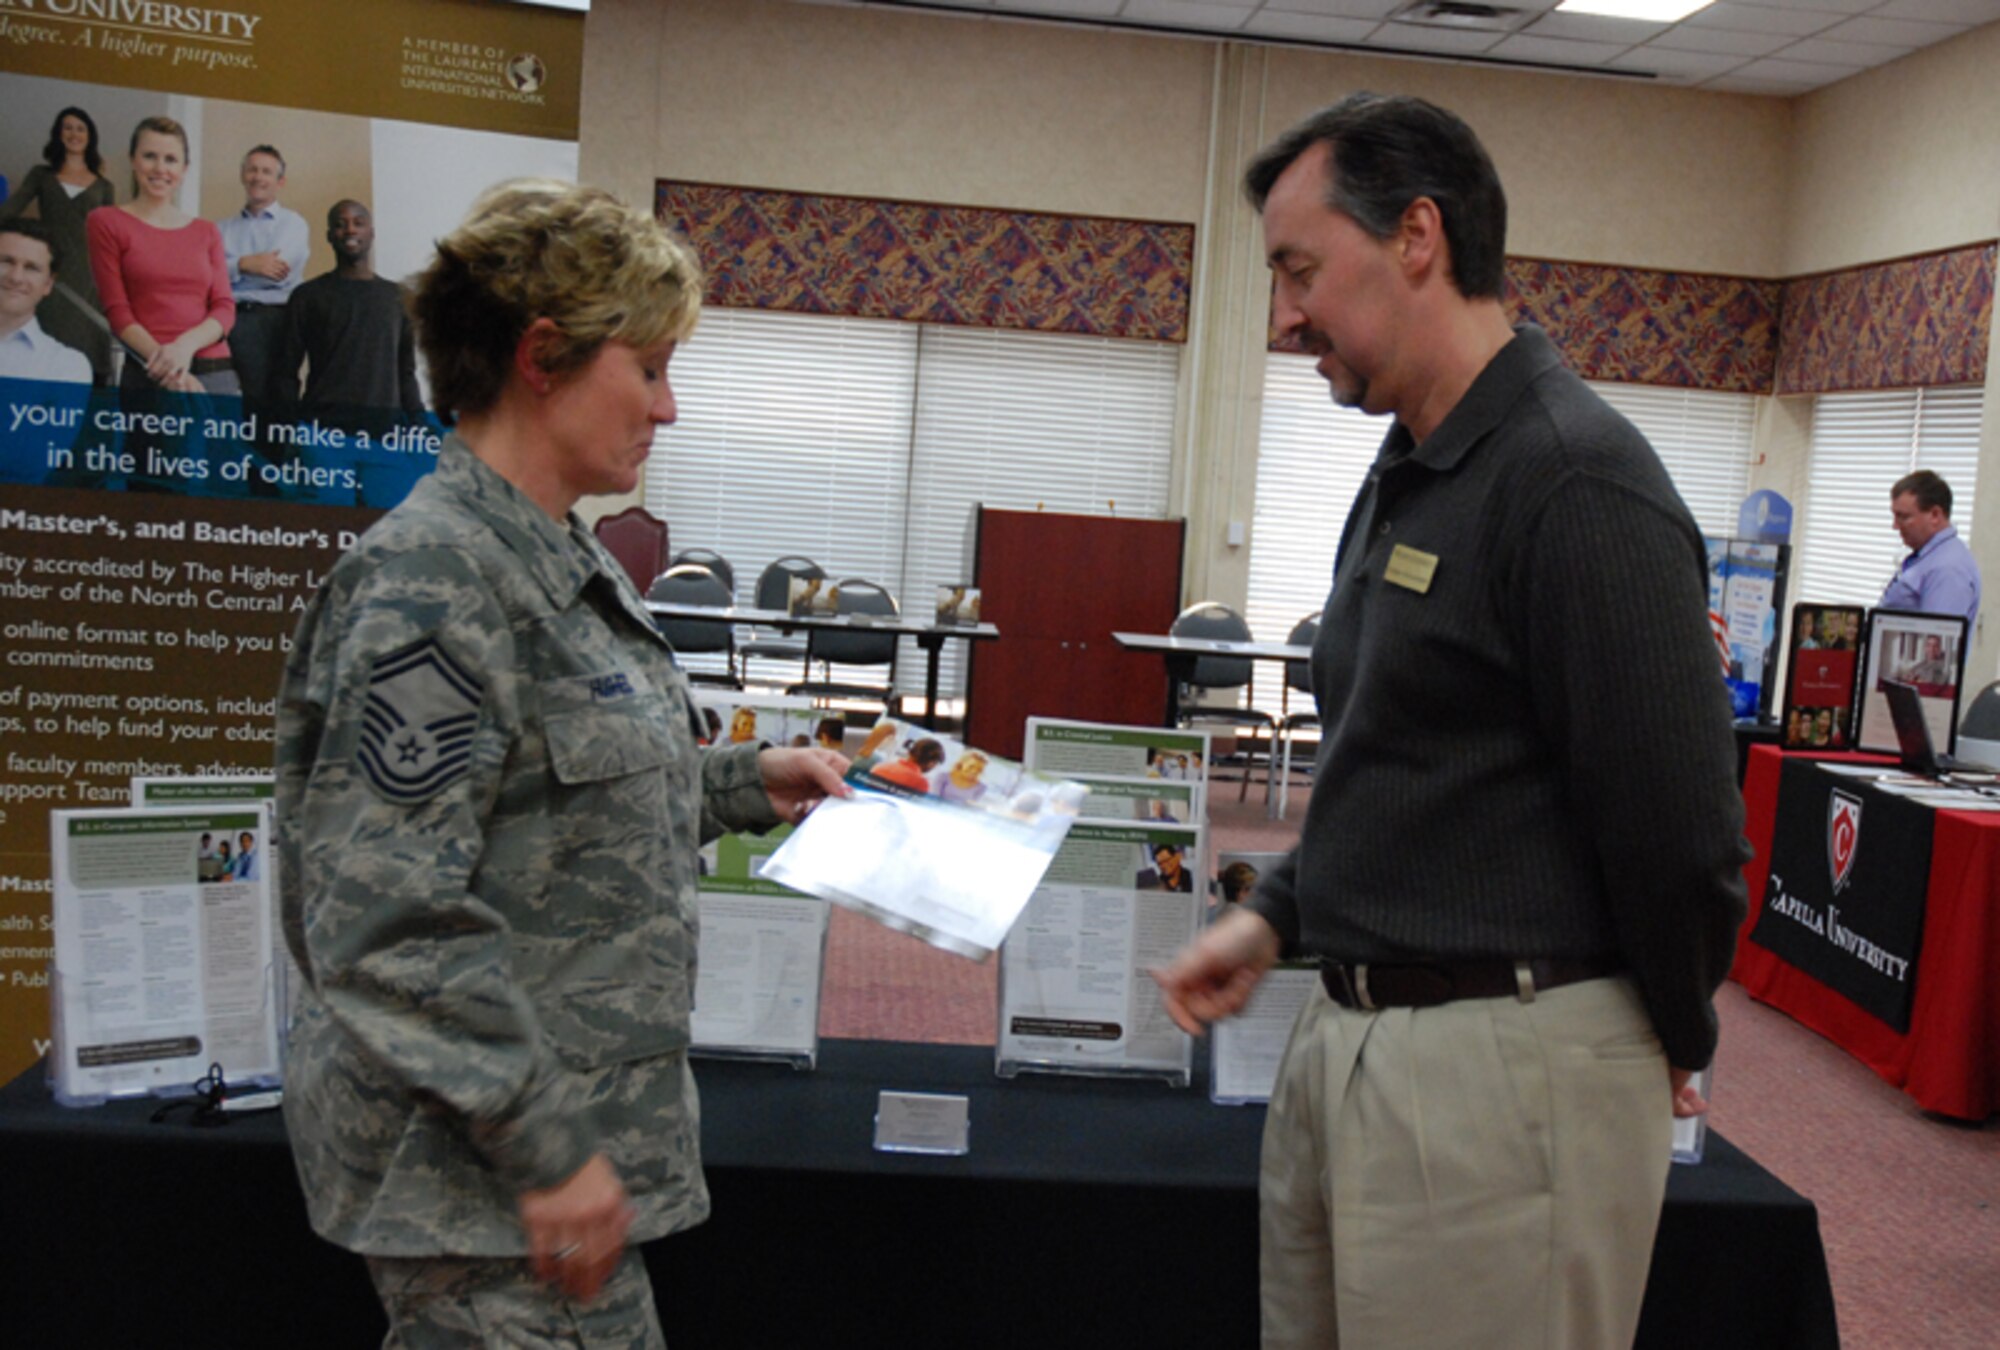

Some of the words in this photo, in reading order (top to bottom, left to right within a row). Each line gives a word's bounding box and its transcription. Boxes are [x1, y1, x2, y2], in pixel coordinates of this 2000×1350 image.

[48, 0, 261, 38] UNIVERSITY
[73, 27, 92, 47] A
[100, 31, 167, 58] higher
[172, 46, 258, 70] purpose.
[403, 50, 430, 62] THE
[434, 55, 505, 73] LAUREATE
[416, 38, 480, 56] MEMBER
[10, 403, 83, 431] your
[94, 408, 193, 437] career
[203, 414, 257, 441] and
[267, 420, 346, 448] make
[355, 430, 371, 450] a
[47, 442, 73, 469] in
[86, 444, 136, 473] the
[147, 447, 209, 479] lives
[221, 452, 253, 481] of
[261, 459, 363, 489] others.
[1, 508, 127, 540] Master's,
[135, 516, 185, 541] and
[194, 521, 329, 551] Bachelor's
[33, 556, 144, 580] accredited
[152, 562, 176, 586] by
[183, 562, 223, 584] The
[230, 566, 300, 591] Higher
[60, 581, 84, 602] of
[89, 583, 123, 605] the
[132, 587, 198, 608] North
[206, 590, 283, 612] Central
[4, 620, 69, 641] online
[76, 622, 148, 646] format
[155, 629, 178, 646] to
[185, 629, 229, 653] help
[236, 636, 273, 654] you
[7, 650, 154, 671] commitments
[1, 685, 23, 705] of
[27, 689, 119, 711] payment
[126, 694, 209, 716] options,
[34, 717, 58, 733] to
[66, 715, 110, 739] help
[118, 717, 164, 738] fund
[170, 724, 218, 743] your
[7, 752, 77, 779] faculty
[84, 755, 189, 777] members,
[75, 780, 132, 800] Team
